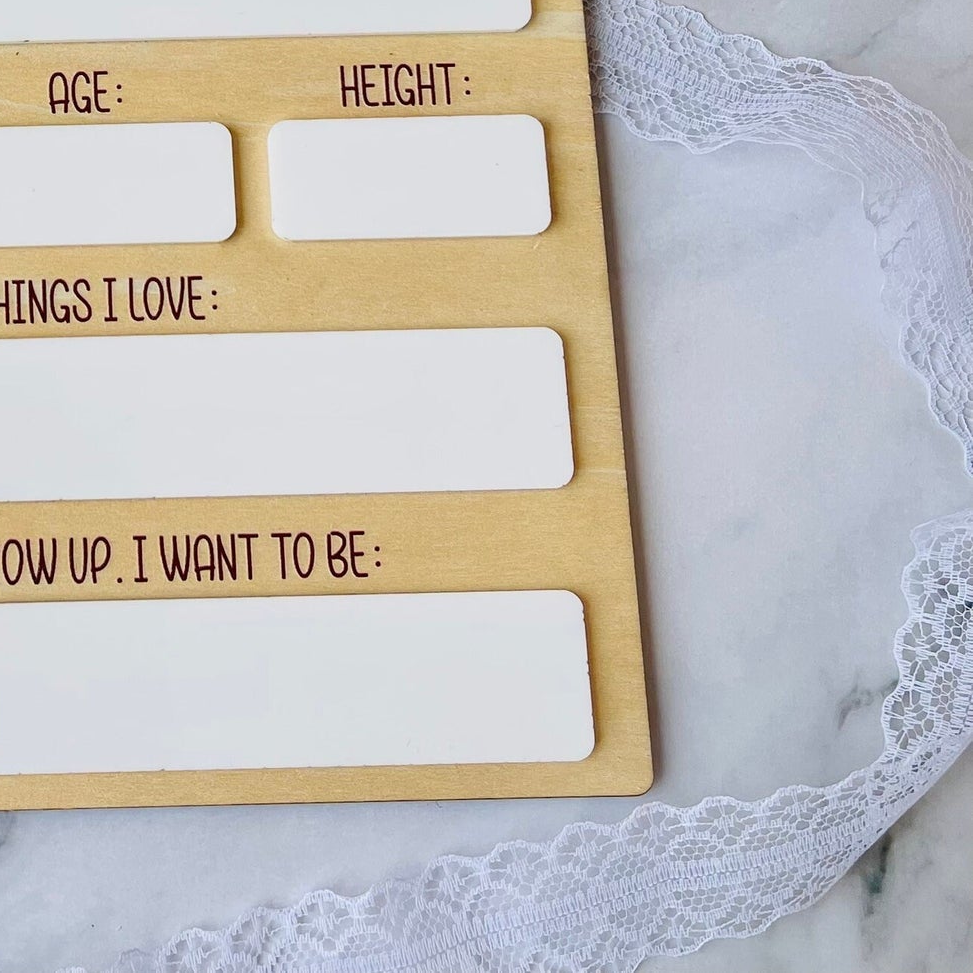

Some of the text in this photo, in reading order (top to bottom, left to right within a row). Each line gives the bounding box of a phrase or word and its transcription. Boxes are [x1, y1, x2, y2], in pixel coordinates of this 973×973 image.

[48, 70, 123, 115] AGE:
[339, 63, 471, 108] HEIGHT:
[102, 277, 118, 323] I
[128, 275, 218, 322] LOVE:
[132, 535, 149, 583] I
[159, 533, 259, 582] WANT
[270, 532, 315, 580] TO
[326, 530, 381, 579] BE:
